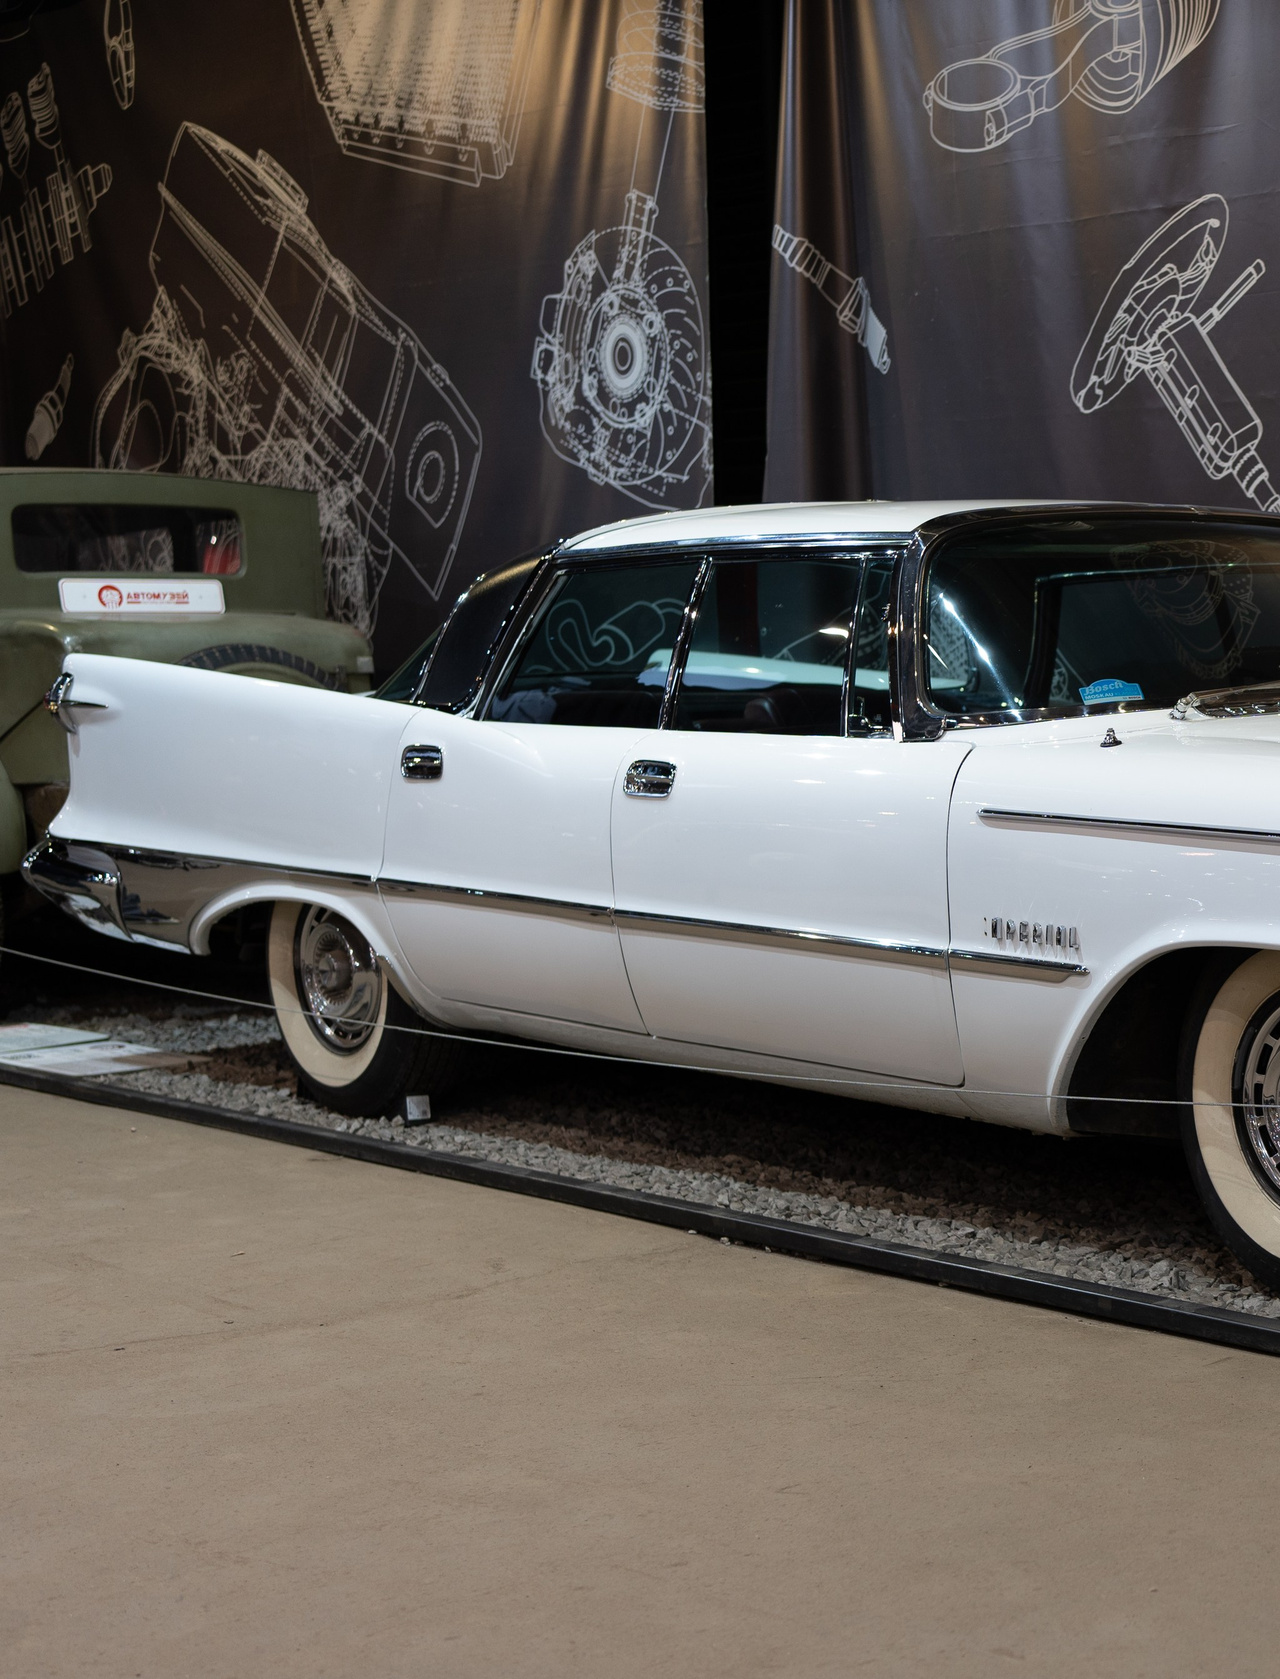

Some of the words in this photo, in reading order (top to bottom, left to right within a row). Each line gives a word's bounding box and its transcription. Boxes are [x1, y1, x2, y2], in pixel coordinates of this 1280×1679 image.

[126, 590, 190, 600] АВТОМУЗЕЙ
[1084, 681, 1124, 696] Bosch
[1085, 692, 1114, 700] MOSKAU
